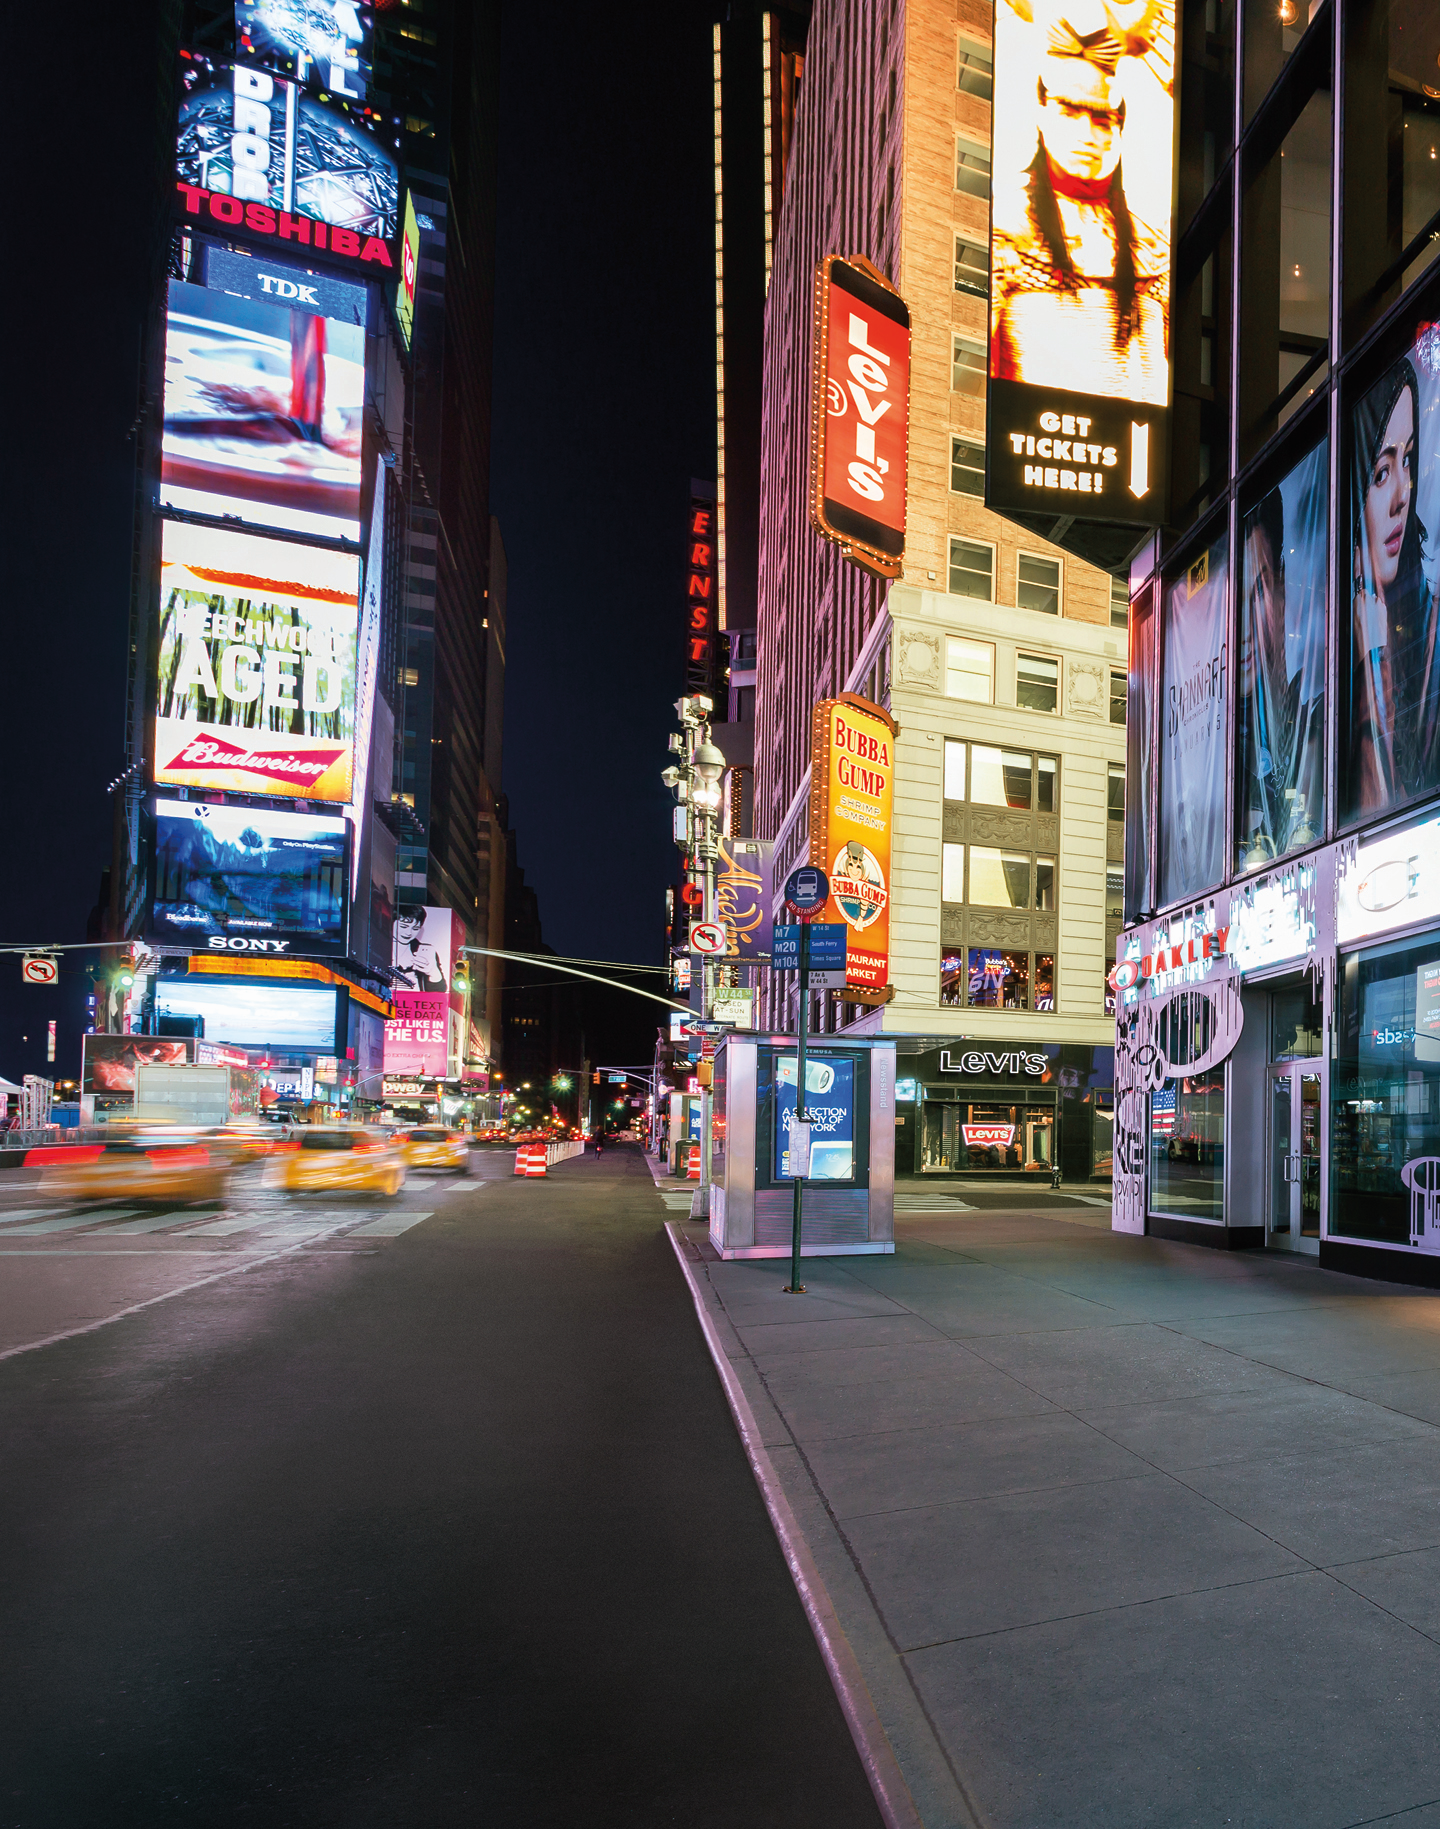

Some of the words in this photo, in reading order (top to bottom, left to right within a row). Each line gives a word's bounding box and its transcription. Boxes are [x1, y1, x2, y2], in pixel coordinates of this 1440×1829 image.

[177, 182, 393, 267] TOSHIBA
[257, 273, 320, 306] TDK
[847, 312, 892, 502] Levi's
[1039, 411, 1092, 437] GET
[1009, 433, 1118, 466] TICKETS
[1024, 465, 1103, 494] HERE!
[688, 511, 711, 661] ERNST
[173, 638, 342, 714] AGED
[1216, 714, 1221, 731] 5
[834, 716, 890, 768] BUBBA
[183, 740, 331, 776] Budweiser
[838, 755, 886, 798] GUMP
[840, 795, 881, 816] SHRIMP
[835, 805, 886, 832] COMPANY
[832, 878, 860, 896] BUBBA
[861, 883, 886, 905] GUMP
[840, 896, 860, 905] SHRIMP
[788, 901, 797, 912] NO
[797, 898, 824, 915] STANDING
[775, 926, 790, 938] M7
[208, 936, 290, 951] SONY
[775, 941, 796, 953] M20
[1142, 926, 1230, 978] OAKLEY
[774, 956, 798, 968] M104
[847, 953, 887, 968] TAURANT
[846, 967, 877, 980] ARKET
[718, 989, 729, 998] W
[730, 989, 743, 998] 44
[414, 1001, 443, 1010] TEXT
[406, 1020, 430, 1028] LIKE
[432, 1021, 444, 1029] IN
[414, 1011, 442, 1020] DATA
[416, 1029, 447, 1043] U.S.
[939, 1050, 1047, 1075] Levi's
[880, 1058, 888, 1109] Newsstand
[782, 1107, 790, 1115] A
[793, 1107, 847, 1116] SLECTION
[829, 1115, 844, 1123] OF
[968, 1129, 1009, 1140] Levi's
